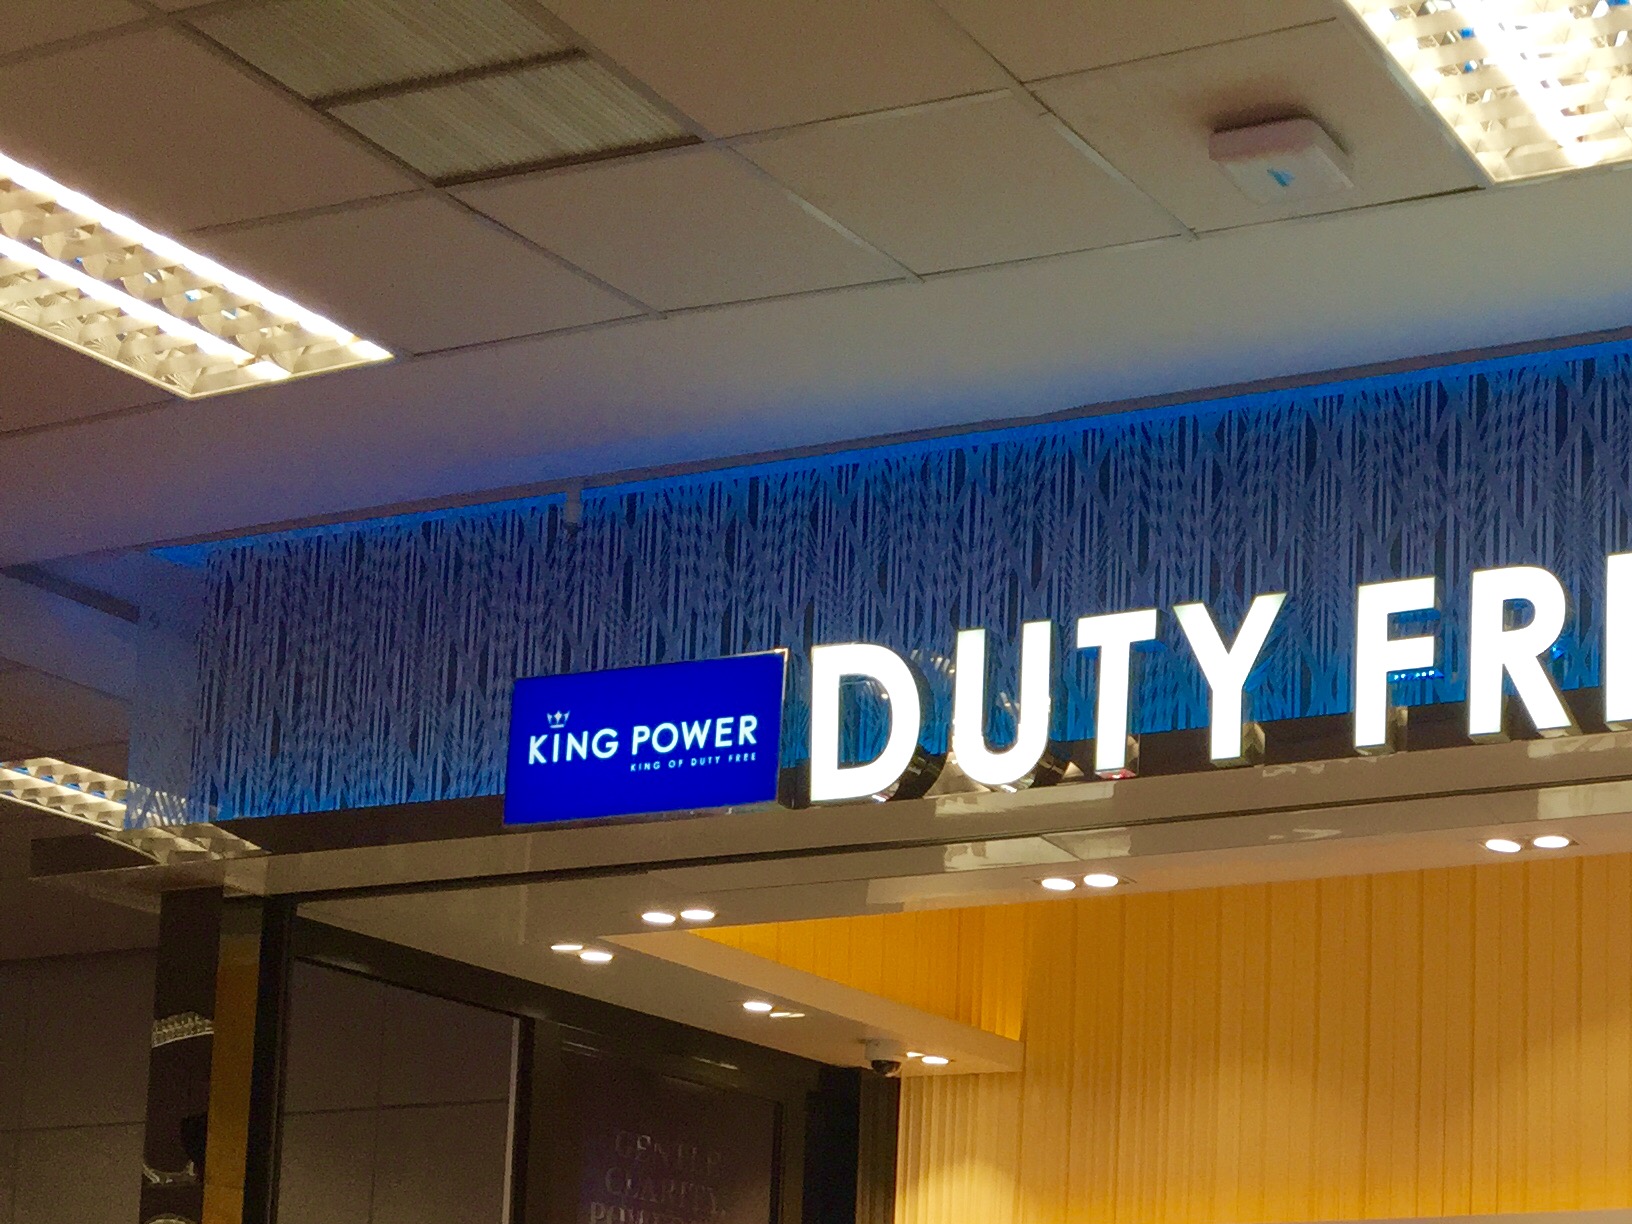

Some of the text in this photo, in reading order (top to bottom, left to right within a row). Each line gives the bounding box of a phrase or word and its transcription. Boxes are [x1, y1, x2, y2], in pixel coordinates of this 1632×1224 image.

[809, 592, 1287, 803] DUTY
[528, 714, 758, 765] KING POWER
[629, 752, 757, 772] KING OF DUTY FREE
